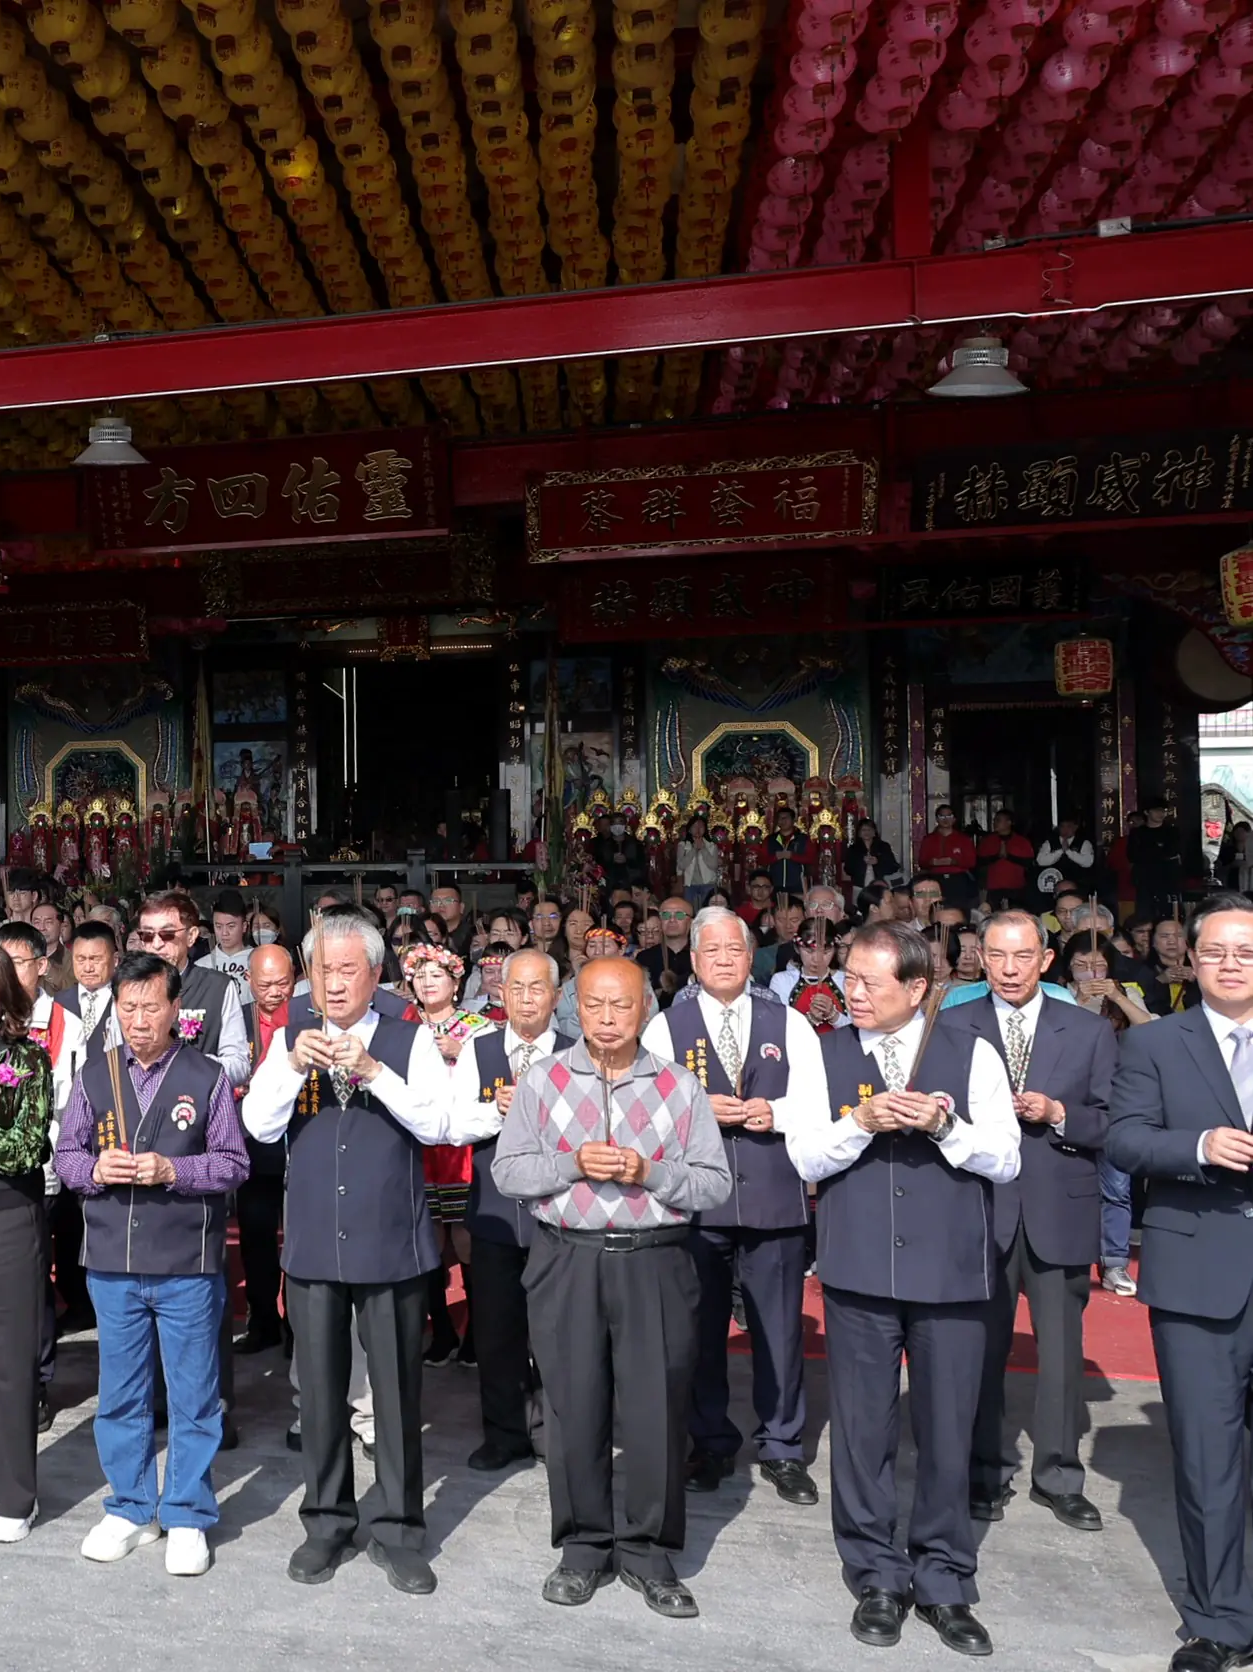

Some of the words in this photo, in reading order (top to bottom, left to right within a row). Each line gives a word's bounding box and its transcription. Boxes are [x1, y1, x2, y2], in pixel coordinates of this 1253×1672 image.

[143, 449, 414, 534] 靈佑四方
[310, 1069, 320, 1115] 主任委員
